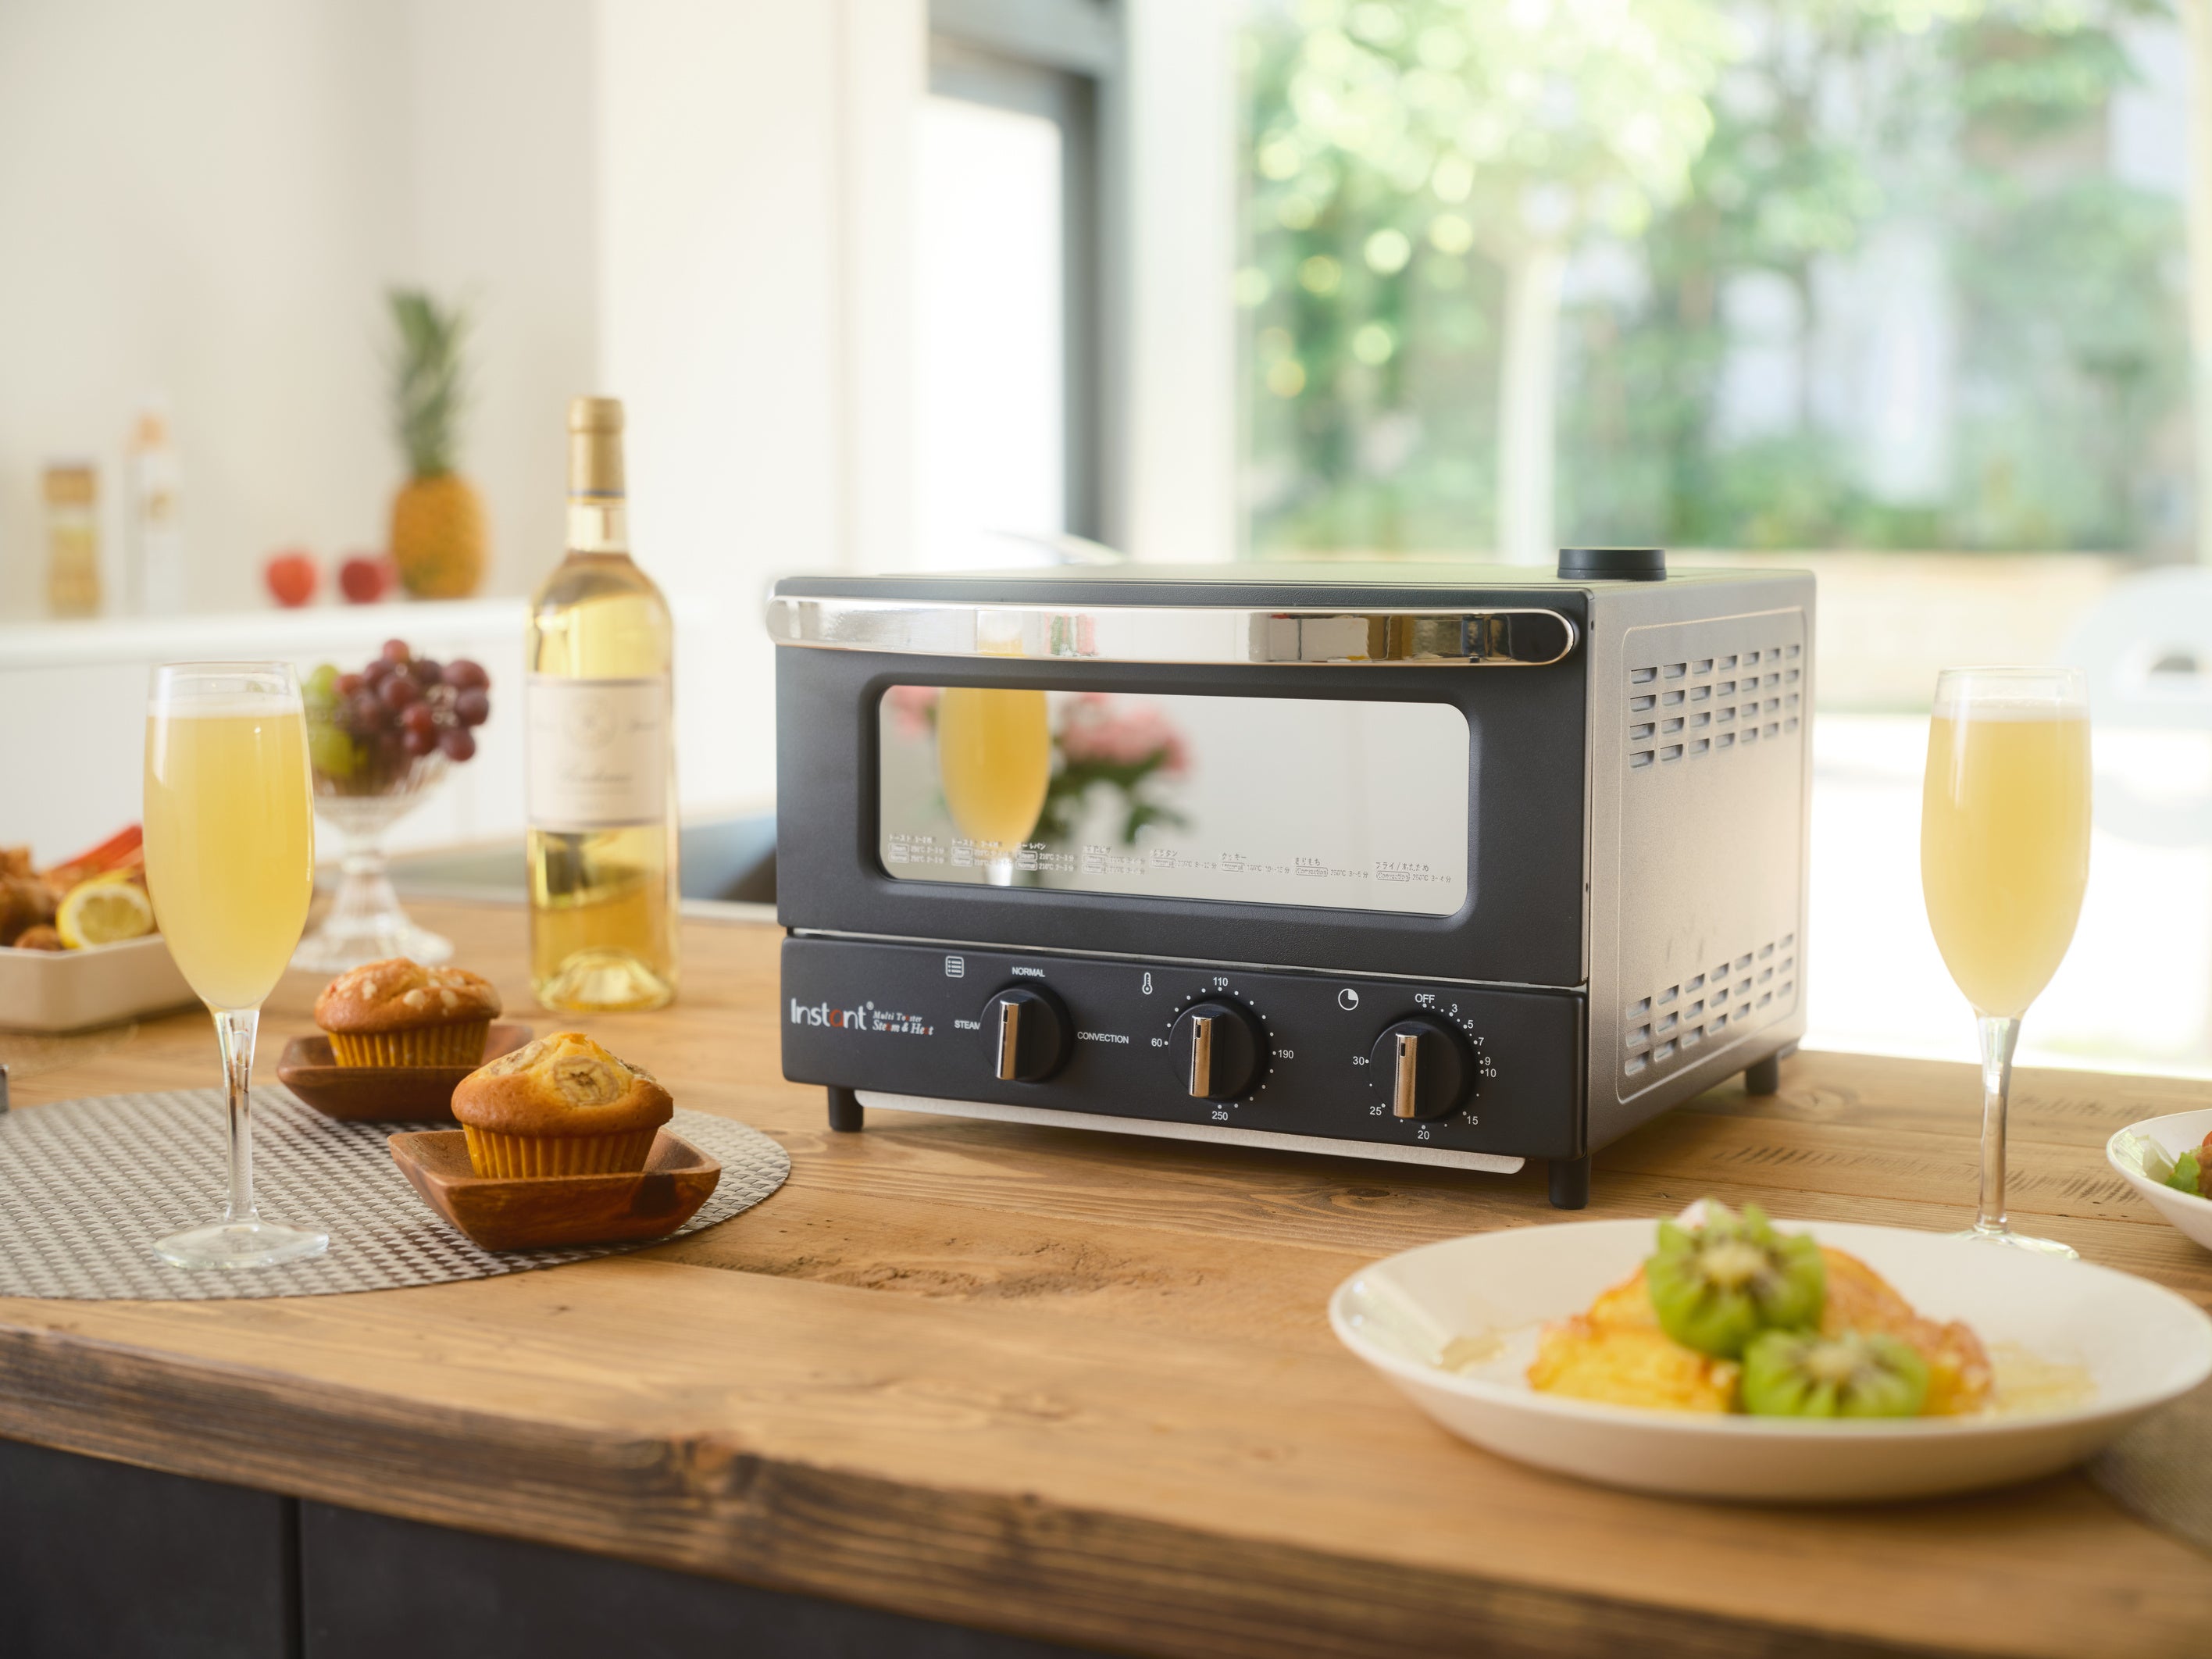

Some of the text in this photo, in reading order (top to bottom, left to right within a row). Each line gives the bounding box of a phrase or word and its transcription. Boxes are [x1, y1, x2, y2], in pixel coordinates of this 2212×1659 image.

[1012, 967, 1045, 977] NORMAL
[1213, 977, 1228, 986] 110
[1415, 994, 1435, 1003] OFF
[1451, 1004, 1458, 1013] 3
[873, 1011, 894, 1021] Multi
[901, 1023, 909, 1033] &
[1467, 1019, 1474, 1029] 5
[1078, 1032, 1129, 1044] CONVECTION
[1478, 1037, 1485, 1046] 7
[1151, 1039, 1163, 1047] 60
[1277, 1050, 1294, 1059] 190
[1352, 1056, 1365, 1065] 30
[1484, 1056, 1491, 1065] 9
[1485, 1069, 1497, 1078] 10
[1369, 1106, 1382, 1116] 25
[1211, 1111, 1229, 1121] 250
[1466, 1115, 1479, 1126] 15
[1418, 1130, 1429, 1140] 20
